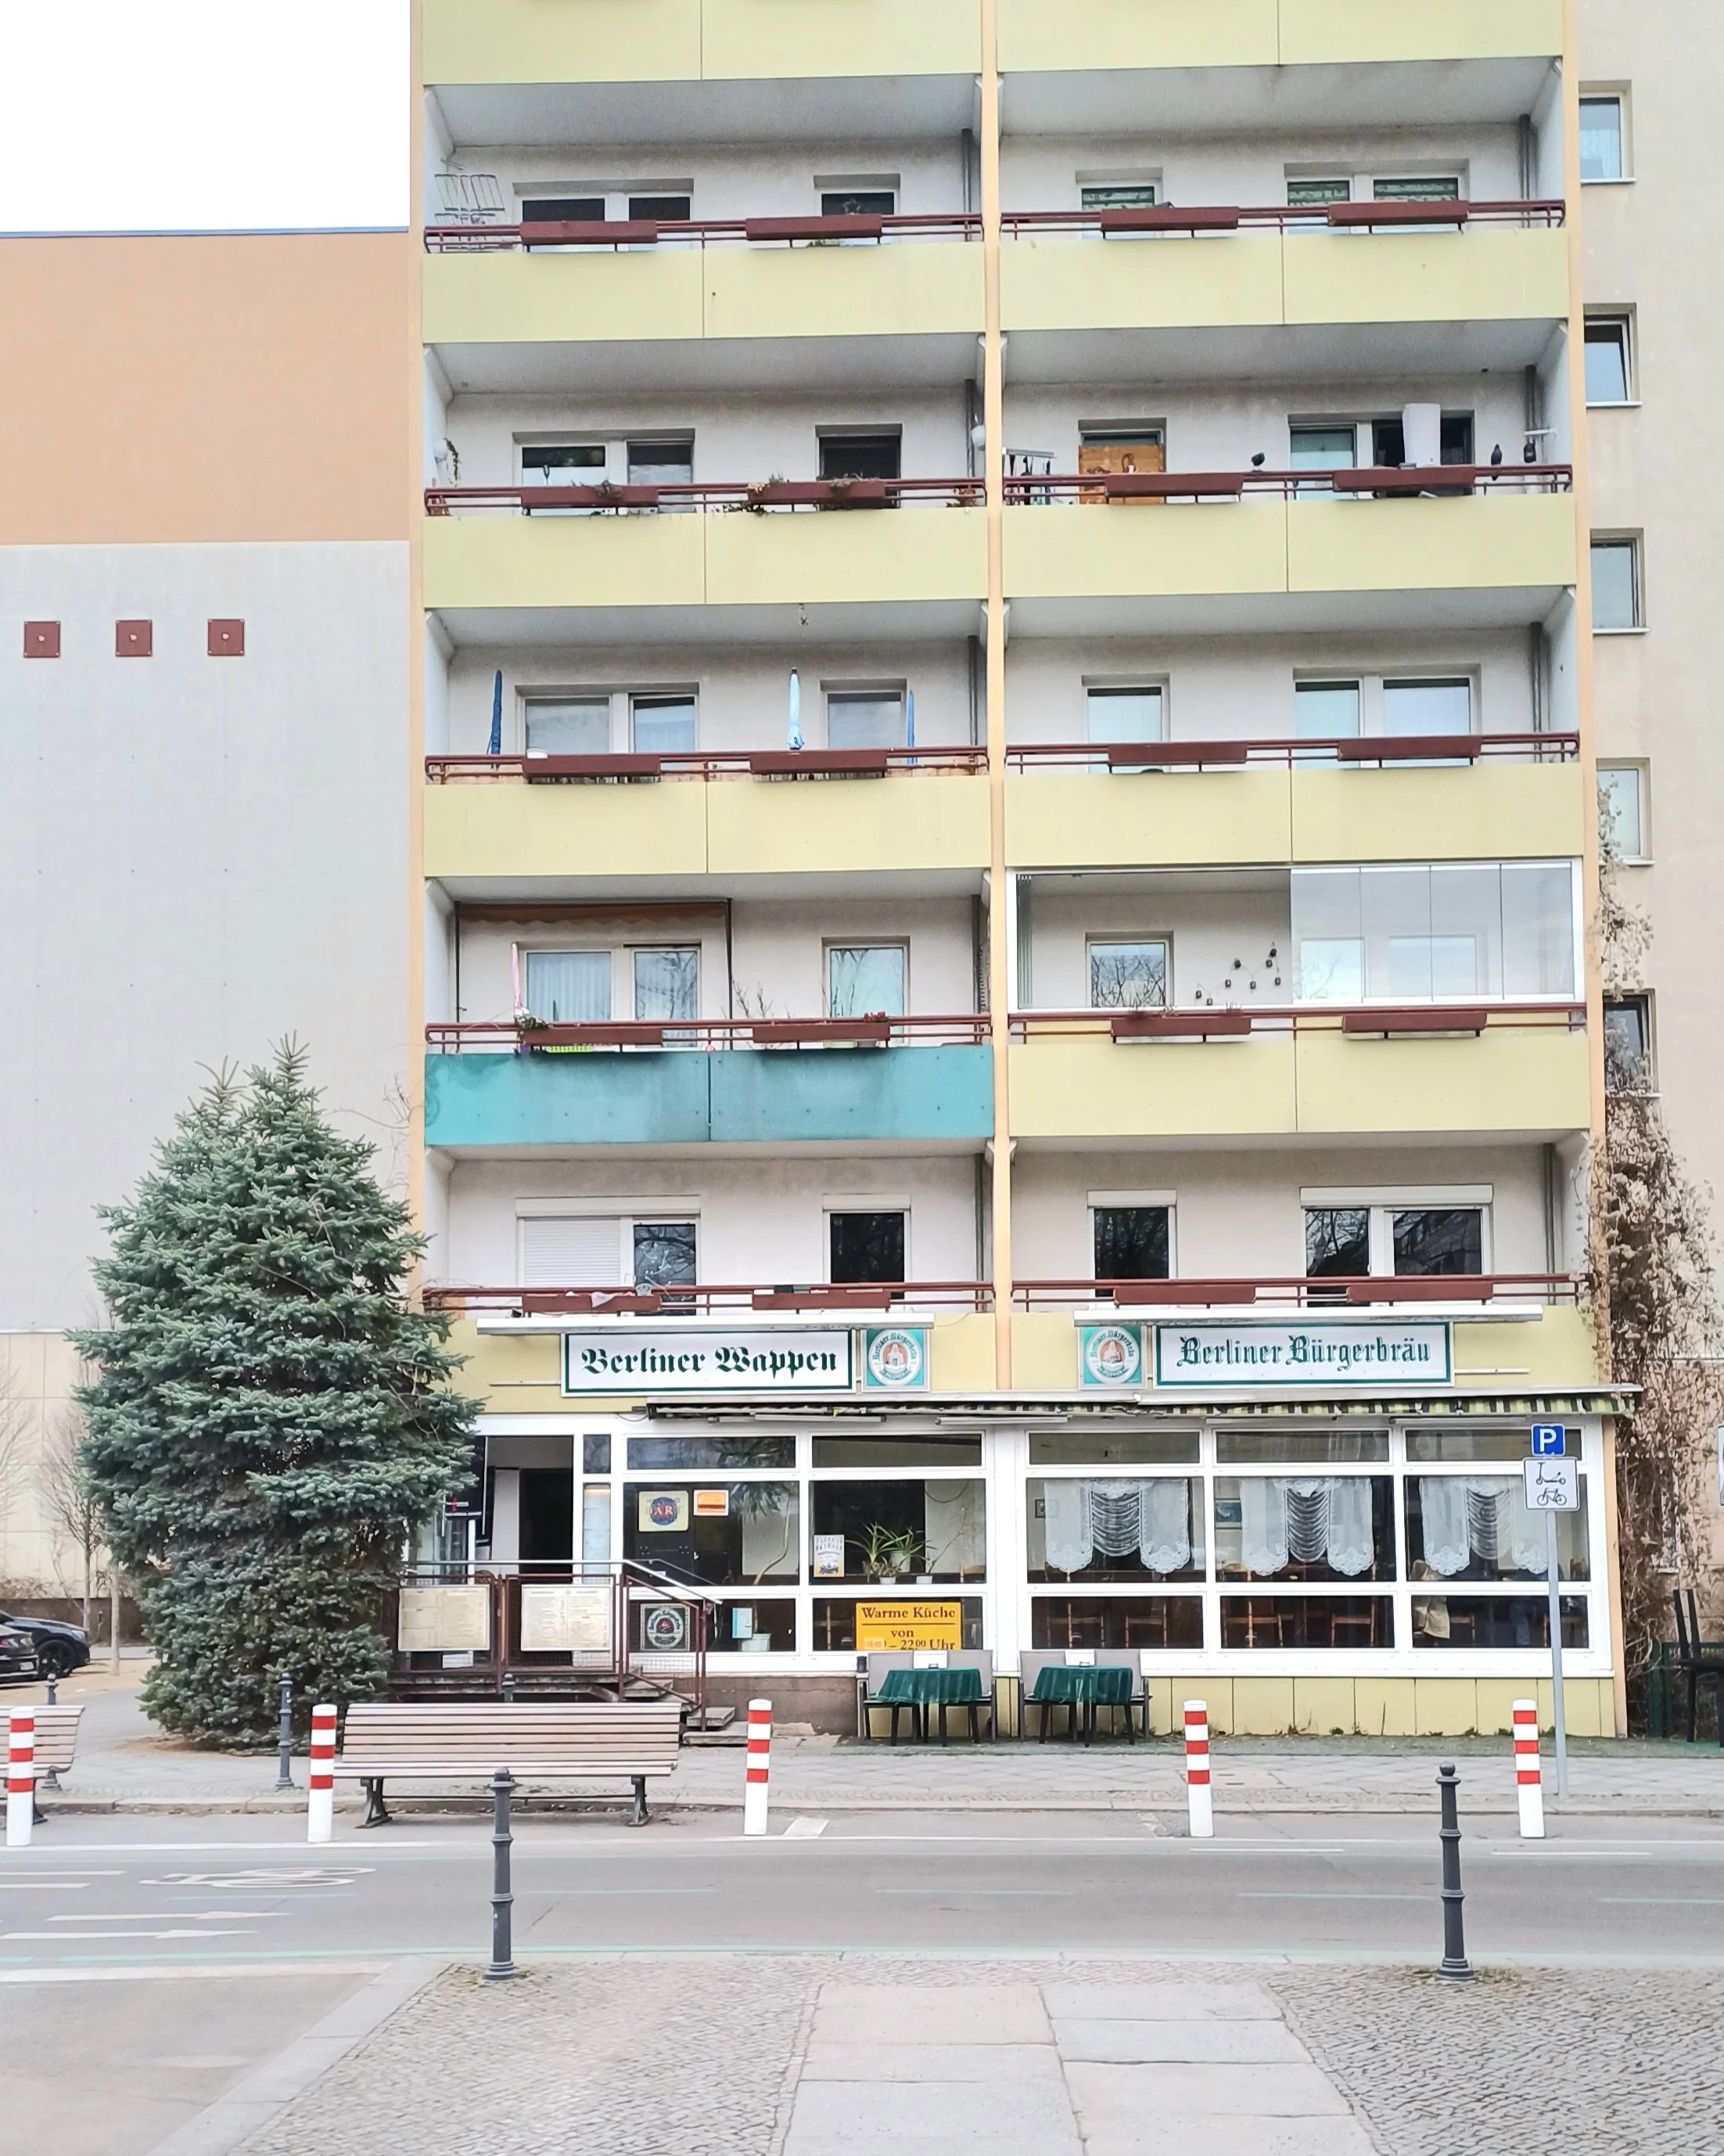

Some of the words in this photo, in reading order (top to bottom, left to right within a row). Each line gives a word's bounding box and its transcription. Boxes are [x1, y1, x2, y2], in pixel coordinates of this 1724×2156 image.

[1176, 1335, 1284, 1367] Berliner
[1285, 1335, 1431, 1371] Bürgerbräu
[581, 1347, 706, 1374] Berliner
[714, 1346, 837, 1379] Wappen
[1539, 1428, 1557, 1452] P
[861, 1607, 909, 1619] Warme
[913, 1606, 956, 1619] Küche
[890, 1630, 914, 1638] von
[929, 1638, 956, 1651] Uhr
